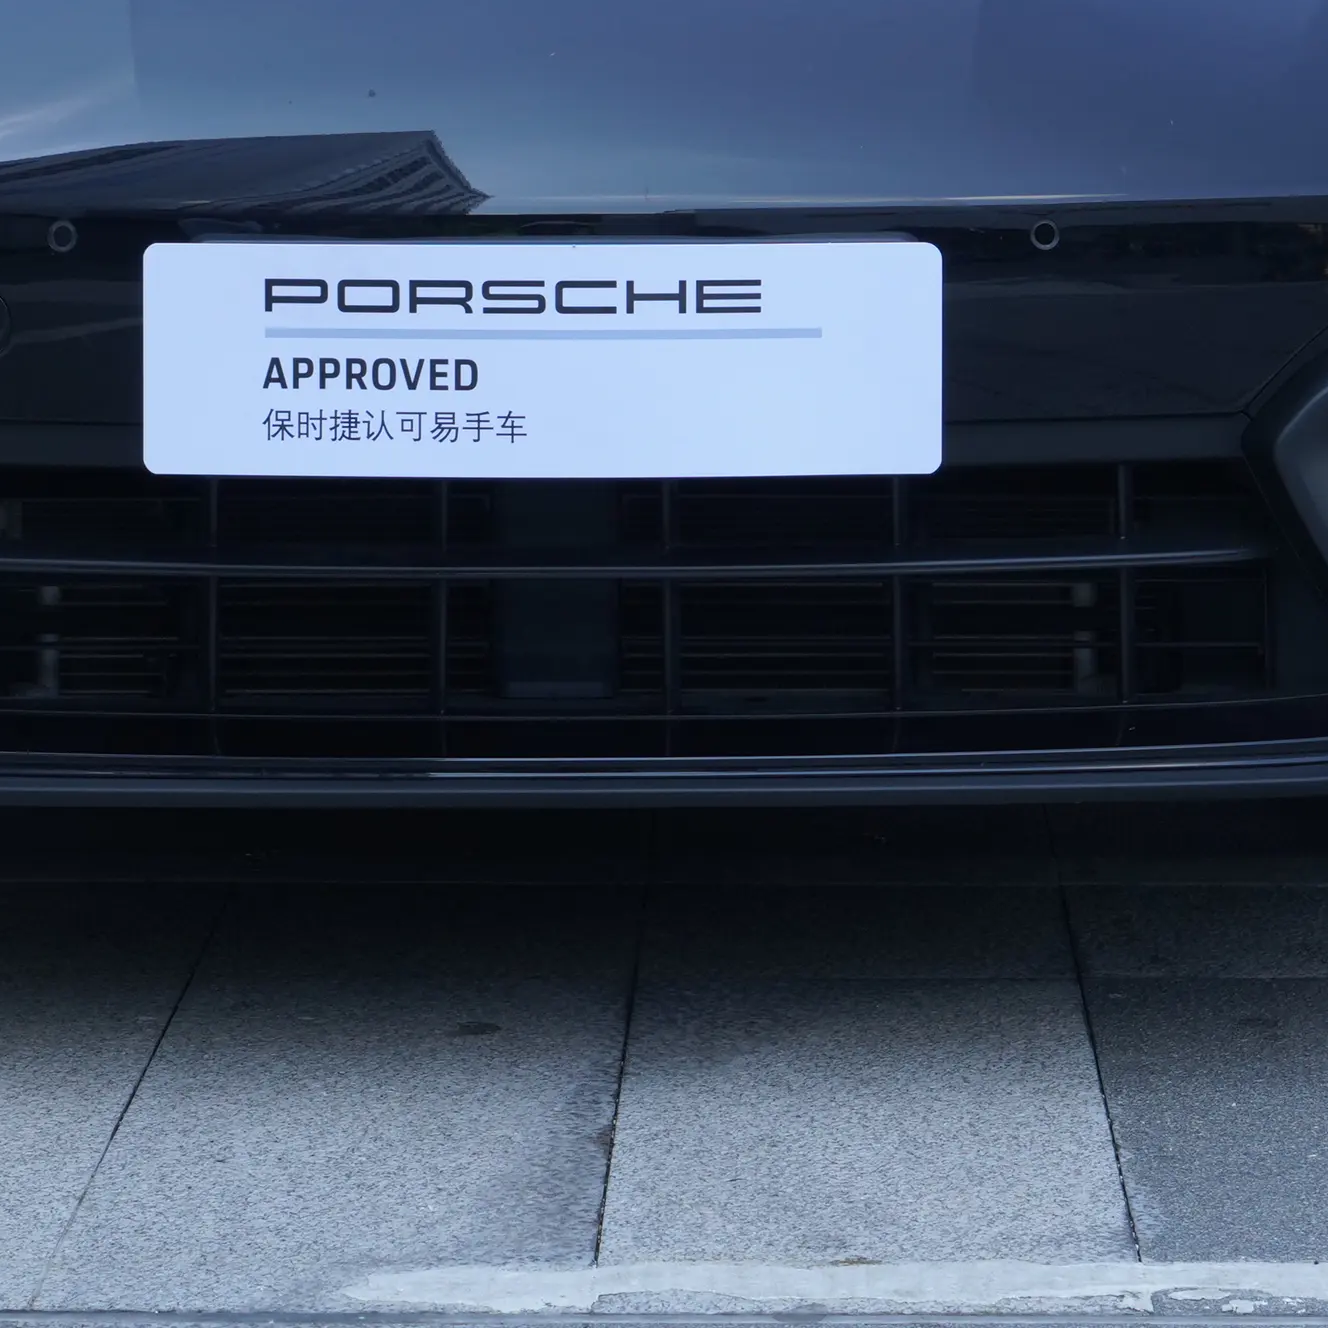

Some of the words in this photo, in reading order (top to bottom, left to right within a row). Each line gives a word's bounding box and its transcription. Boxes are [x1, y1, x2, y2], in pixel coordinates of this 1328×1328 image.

[264, 278, 762, 315] PORSCHE
[262, 357, 479, 391] APPROVED
[262, 408, 528, 444] 保时捷认可易手车
